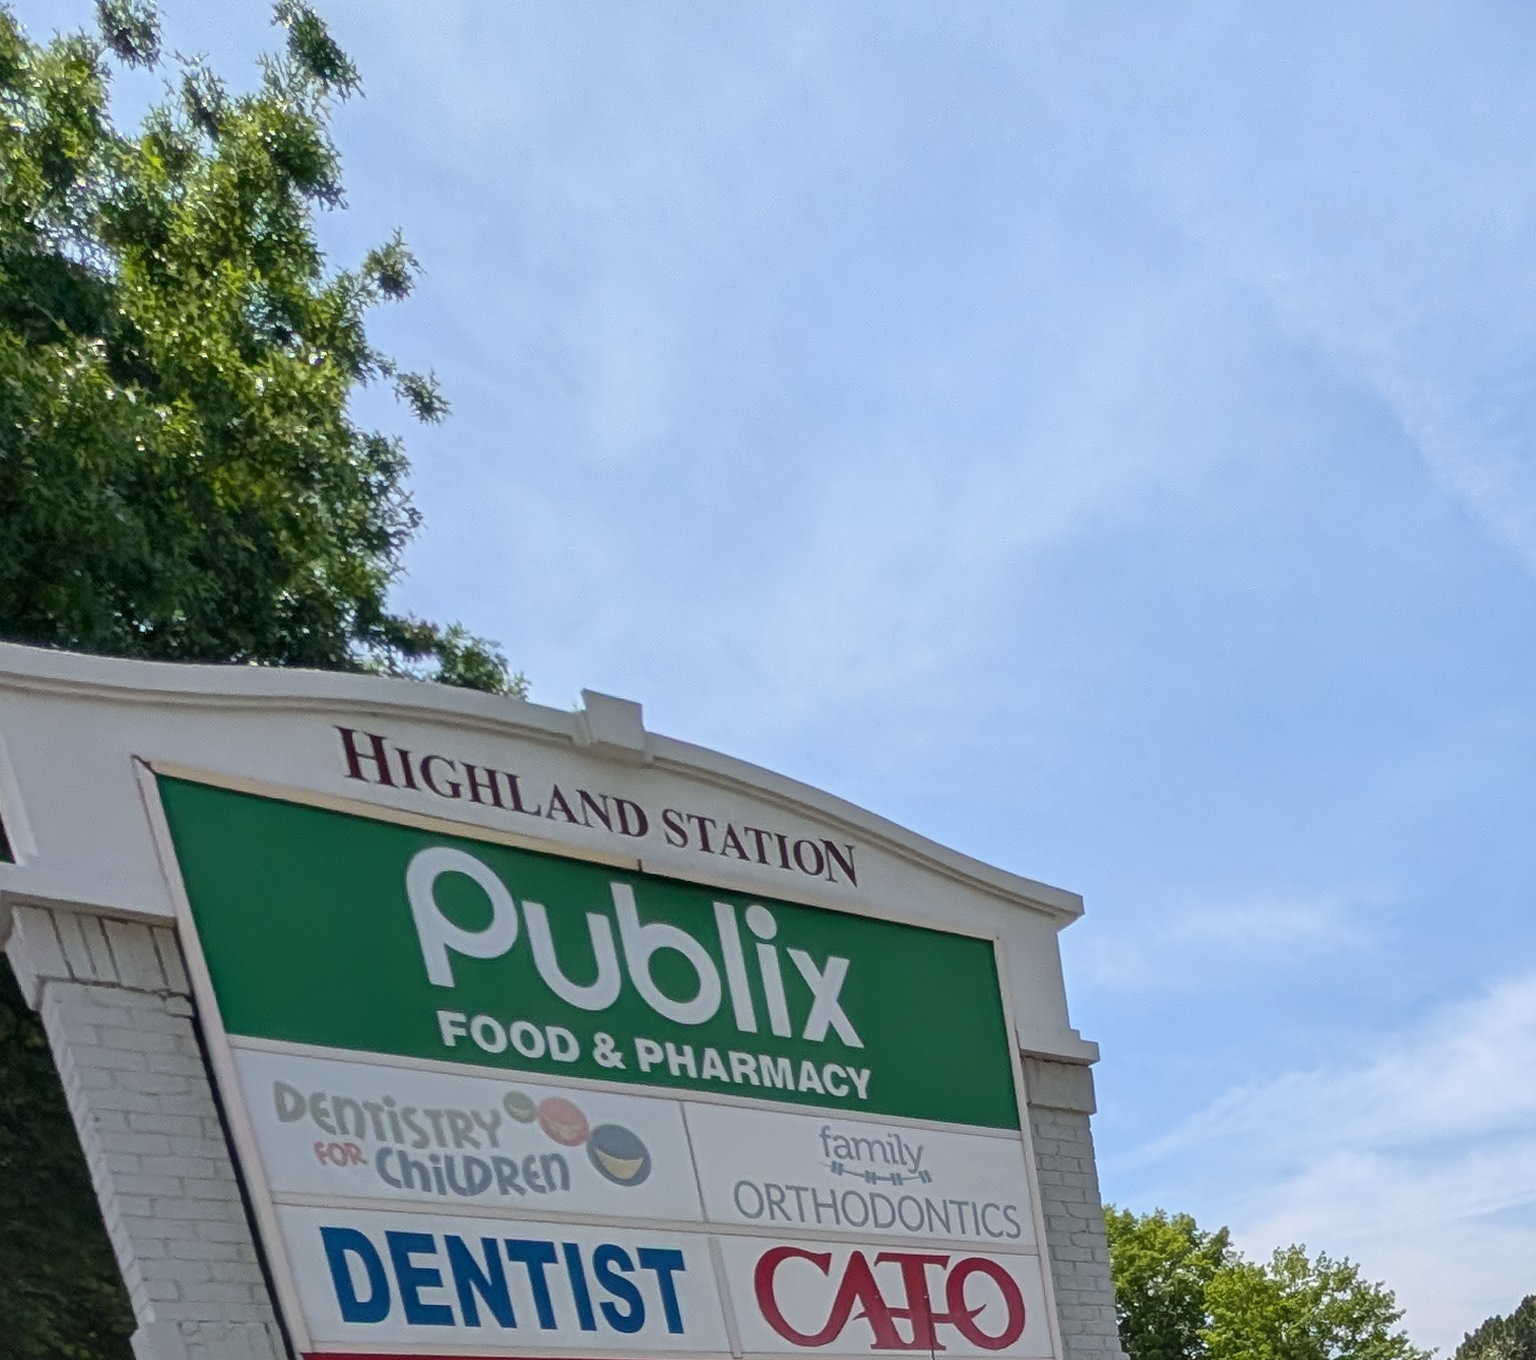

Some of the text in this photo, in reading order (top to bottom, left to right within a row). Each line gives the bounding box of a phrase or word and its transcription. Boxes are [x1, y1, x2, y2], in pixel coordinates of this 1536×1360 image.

[334, 726, 860, 888] HIGHLAND STATION
[405, 846, 865, 1049] Publix
[436, 1009, 871, 1101] FOOD & PHARMACY
[313, 1141, 367, 1167] FOR
[819, 1125, 924, 1174] family
[733, 1180, 1022, 1240] ORTHODONTICS
[319, 1226, 686, 1335] DENTIST
[754, 1246, 1026, 1351] CATO
